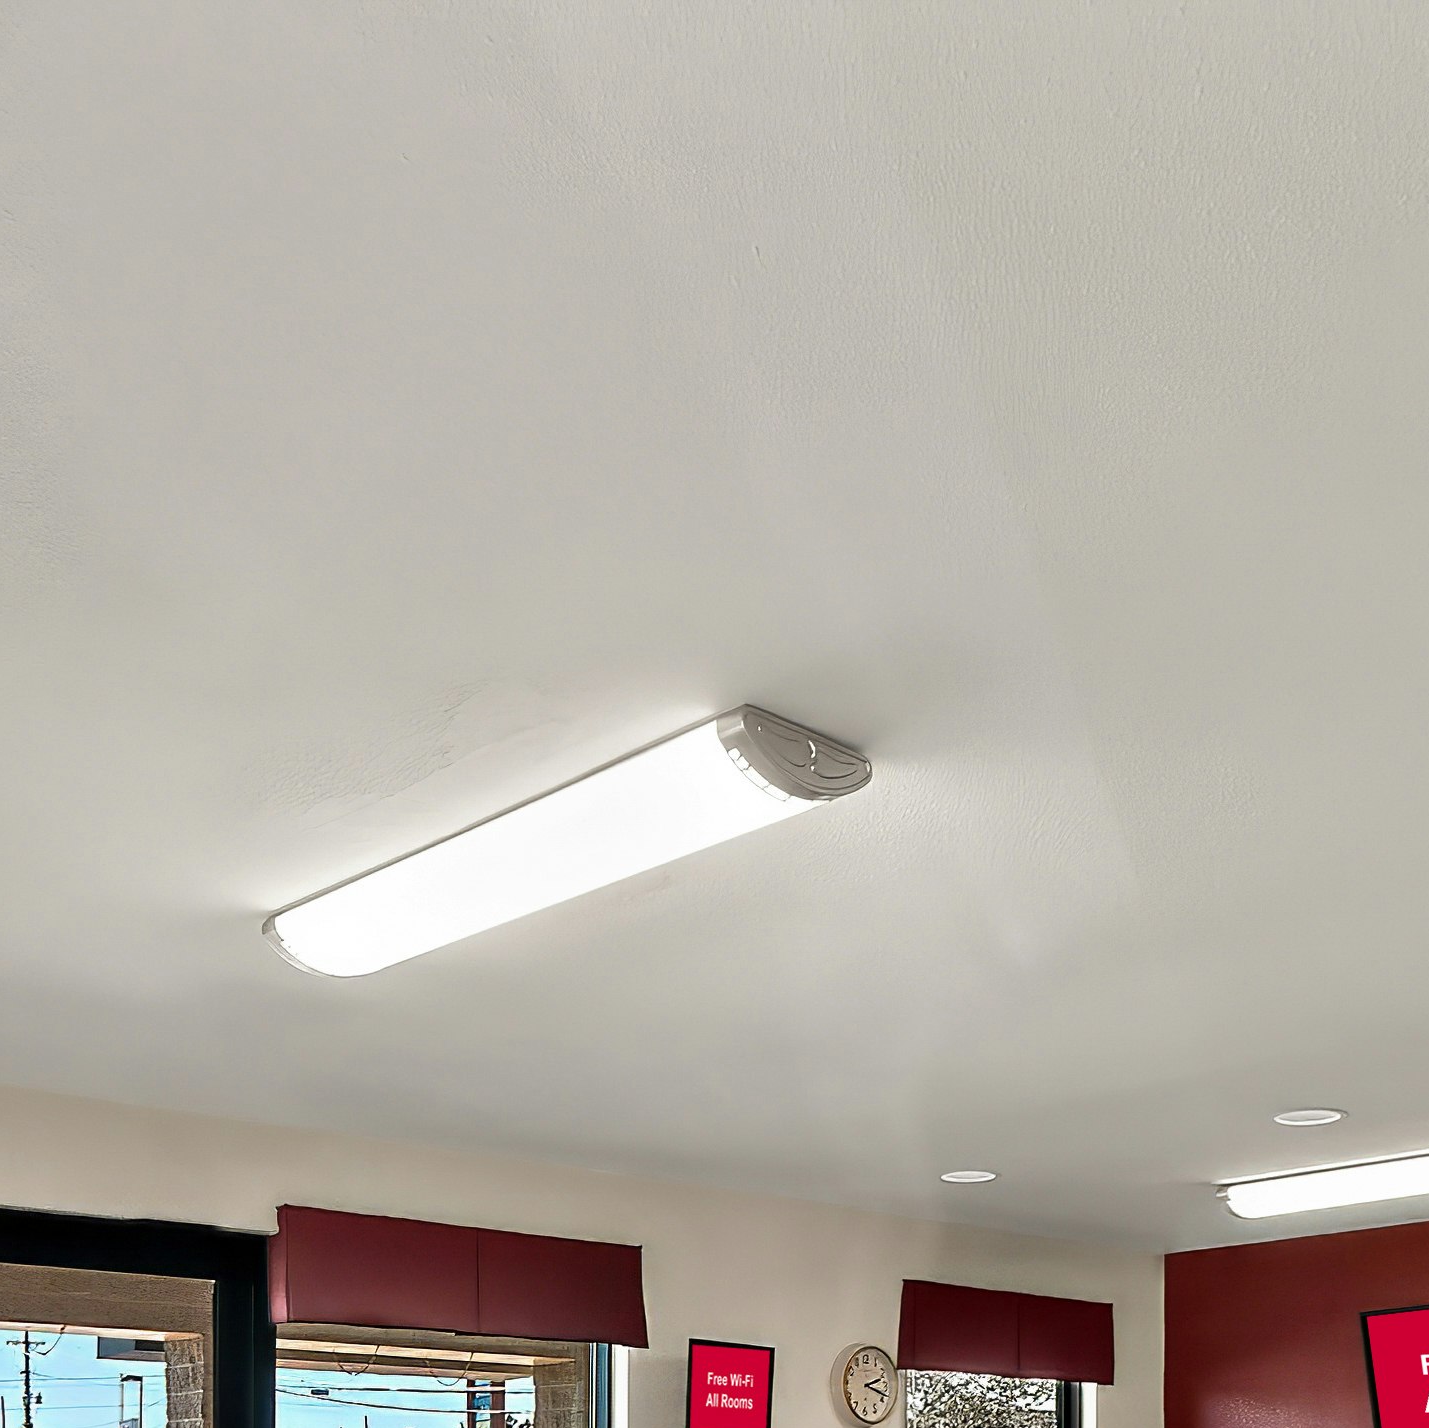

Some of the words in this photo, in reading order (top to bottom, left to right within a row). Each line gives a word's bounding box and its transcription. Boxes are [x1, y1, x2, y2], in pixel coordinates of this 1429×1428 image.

[707, 1371, 728, 1386] Free
[729, 1373, 754, 1388] Wi-Fi
[705, 1392, 719, 1408] All
[720, 1393, 754, 1410] Rooms
